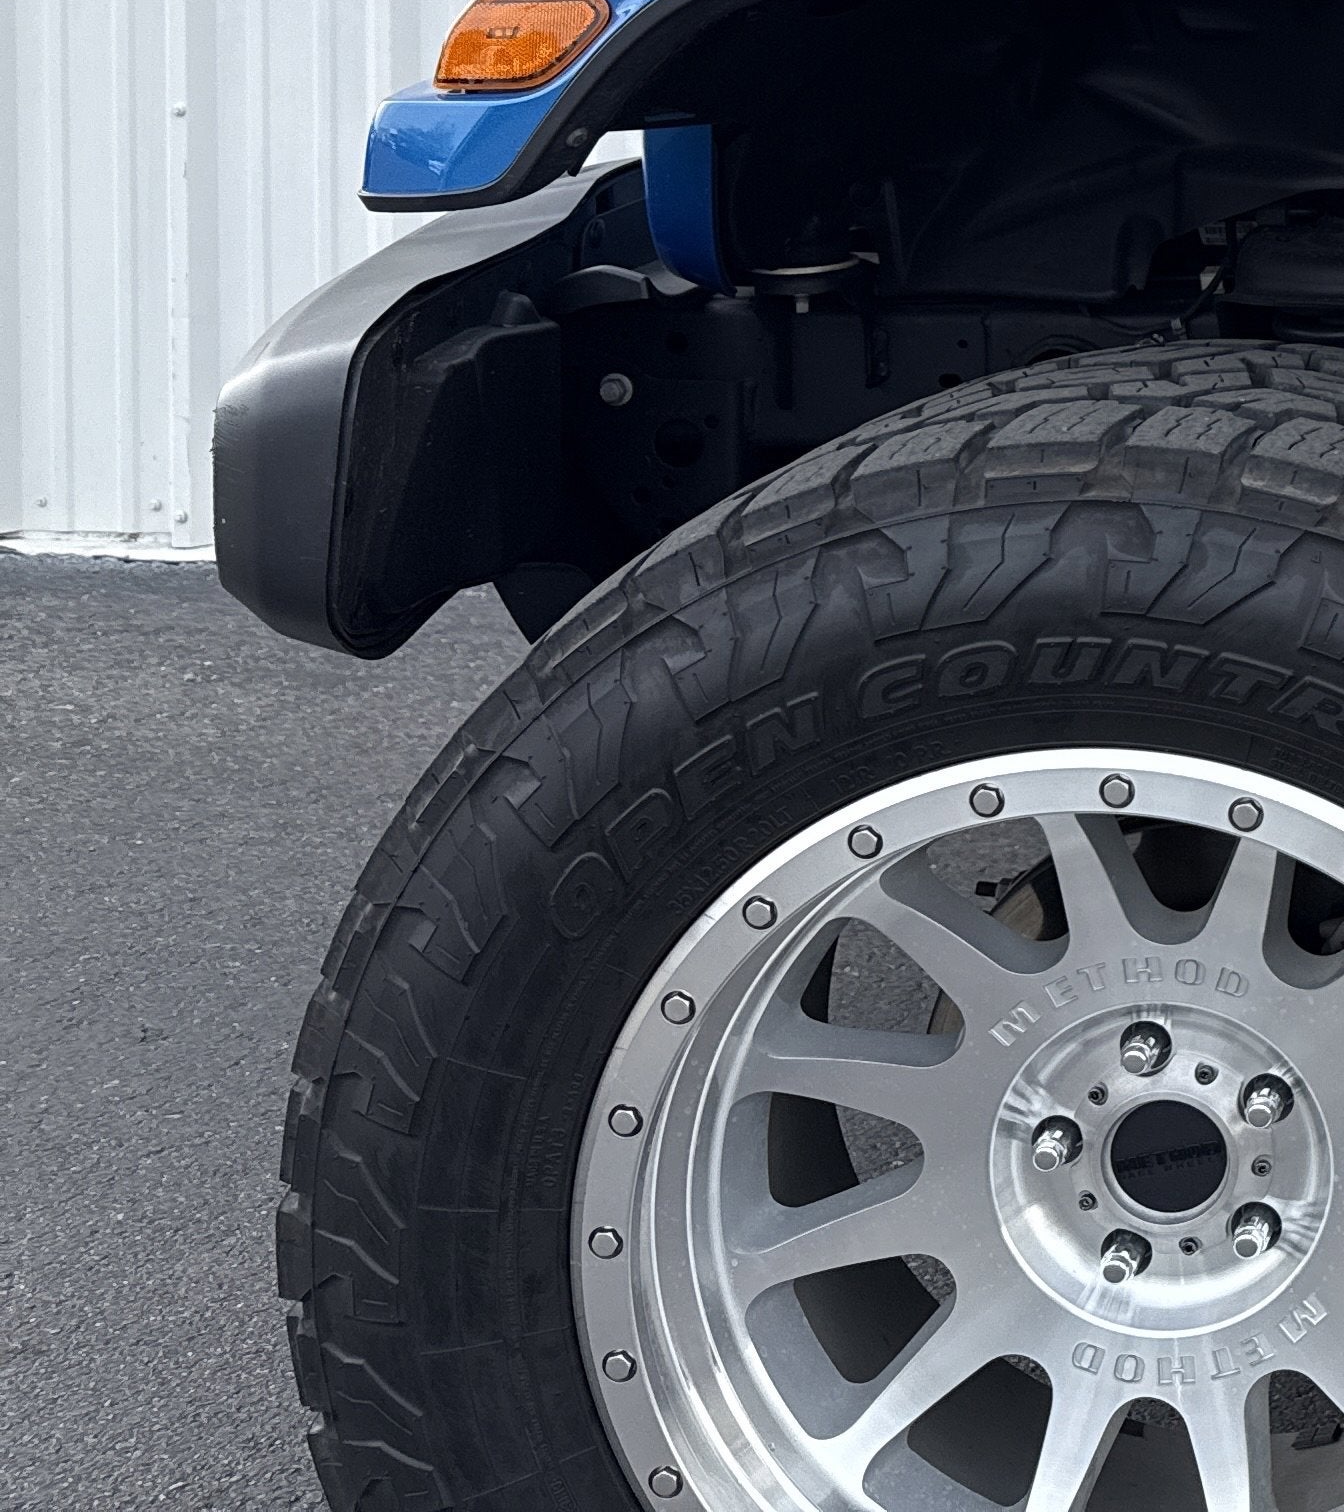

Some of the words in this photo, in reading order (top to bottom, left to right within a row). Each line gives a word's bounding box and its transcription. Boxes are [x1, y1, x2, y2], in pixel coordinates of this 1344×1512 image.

[549, 690, 826, 940] OPEN
[988, 957, 1249, 1046] METHOD
[1072, 1289, 1328, 1385] METHOD
